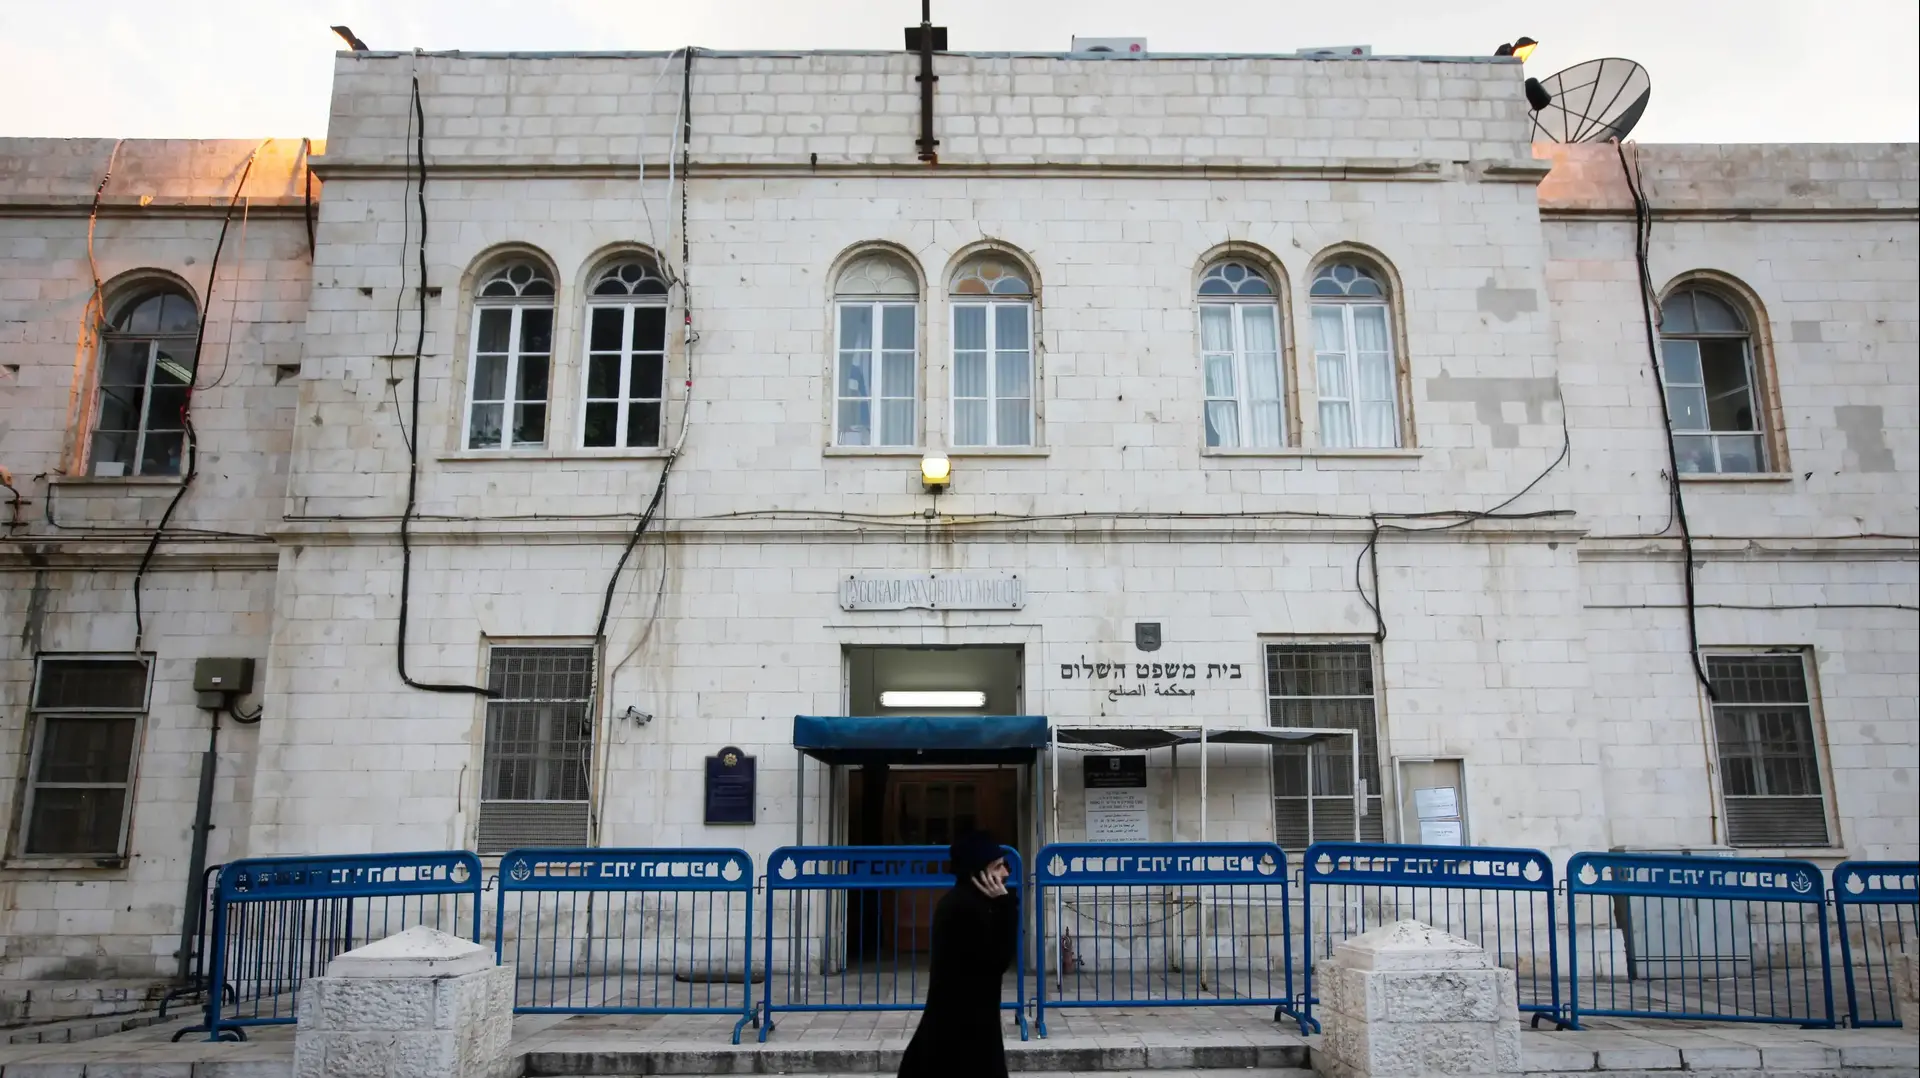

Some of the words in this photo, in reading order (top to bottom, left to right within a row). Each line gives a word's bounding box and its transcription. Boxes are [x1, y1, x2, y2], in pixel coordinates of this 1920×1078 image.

[844, 579, 901, 603] РУССКАЯ
[1060, 655, 1126, 679] השלום
[1135, 663, 1196, 679] משפט
[1206, 663, 1242, 679] בית
[1108, 683, 1146, 702] الصلح
[1154, 683, 1196, 697] محكمة
